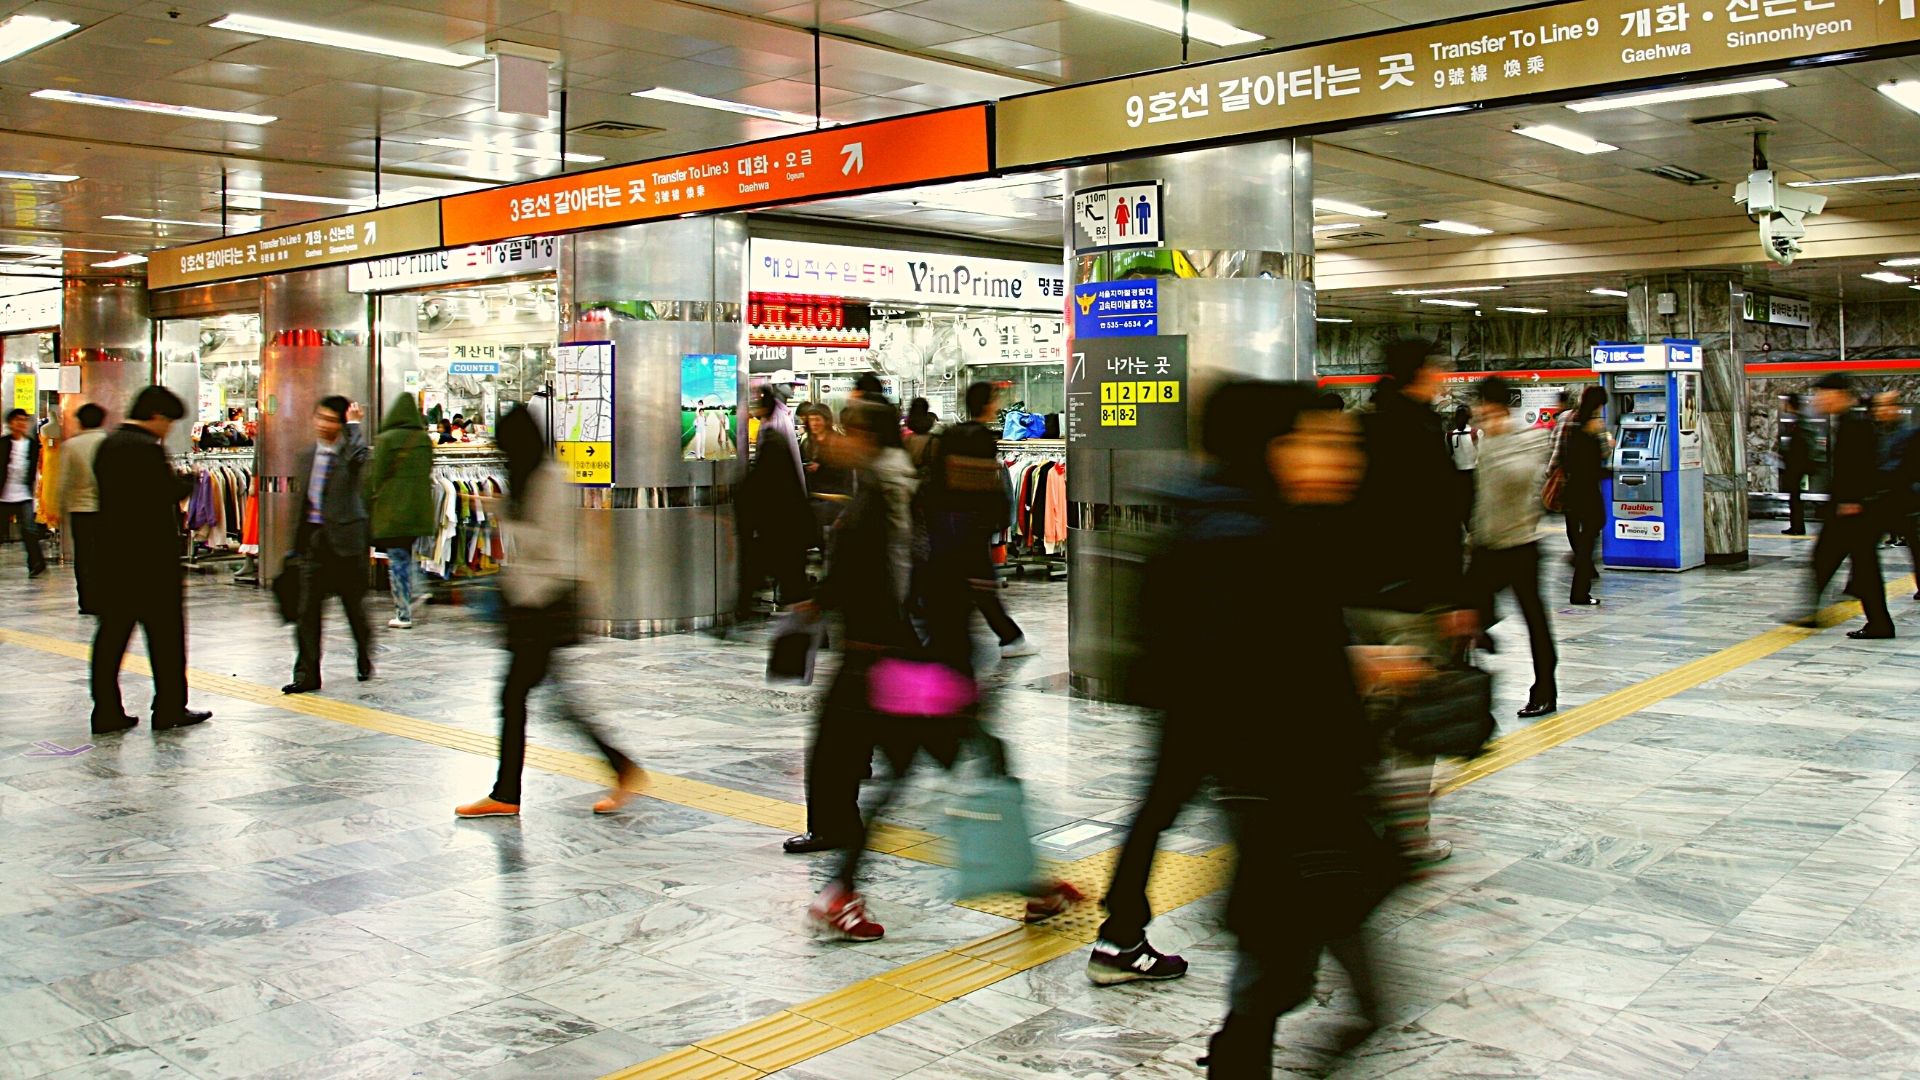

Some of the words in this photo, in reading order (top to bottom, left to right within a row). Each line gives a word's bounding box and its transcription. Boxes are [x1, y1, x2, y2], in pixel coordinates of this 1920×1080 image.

[1620, 4, 1691, 38] 개화
[1430, 31, 1506, 61] Transfer
[1509, 29, 1536, 49] To
[1539, 22, 1583, 45] Line
[1586, 17, 1599, 37] 9
[1621, 41, 1691, 64] Gaehwa
[1726, 18, 1852, 48] Sinnonhyeon
[1126, 88, 1209, 128] 9호선
[1218, 65, 1361, 114] 갈아타는
[1378, 52, 1415, 89] 곳
[737, 153, 769, 177] 대화
[785, 148, 813, 169] 오금
[652, 169, 688, 186] Transfer
[688, 167, 701, 181] To
[701, 164, 722, 178] Line
[722, 162, 729, 175] 3
[738, 180, 770, 194] Daehwa
[786, 171, 805, 182] Ogeum
[510, 193, 550, 222] 3호선
[554, 183, 622, 214] 갈아타는
[628, 179, 646, 204] 곳
[1076, 201, 1084, 210] B1
[1086, 193, 1106, 204] 110m
[305, 231, 322, 246] 개화
[330, 224, 355, 242] 신논현
[1096, 226, 1107, 235] B2
[180, 254, 207, 274] 9호선
[206, 247, 244, 269] 갈아타는
[247, 243, 257, 263] 곳
[907, 261, 1023, 299] VinPrime
[1038, 277, 1064, 296] 명품
[1106, 320, 1141, 329] 535-6534
[454, 345, 495, 359] 계산대
[453, 363, 495, 373] COUNTER
[1107, 356, 1149, 375] 나가는
[1154, 356, 1171, 375] 곳
[1105, 386, 1111, 400] 1
[1122, 386, 1130, 400] 2
[1142, 386, 1151, 399] 7
[1163, 385, 1173, 399] 8
[1102, 409, 1116, 421] 8-1
[1119, 408, 1135, 421] 8-2
[1620, 503, 1654, 511] Nautilus
